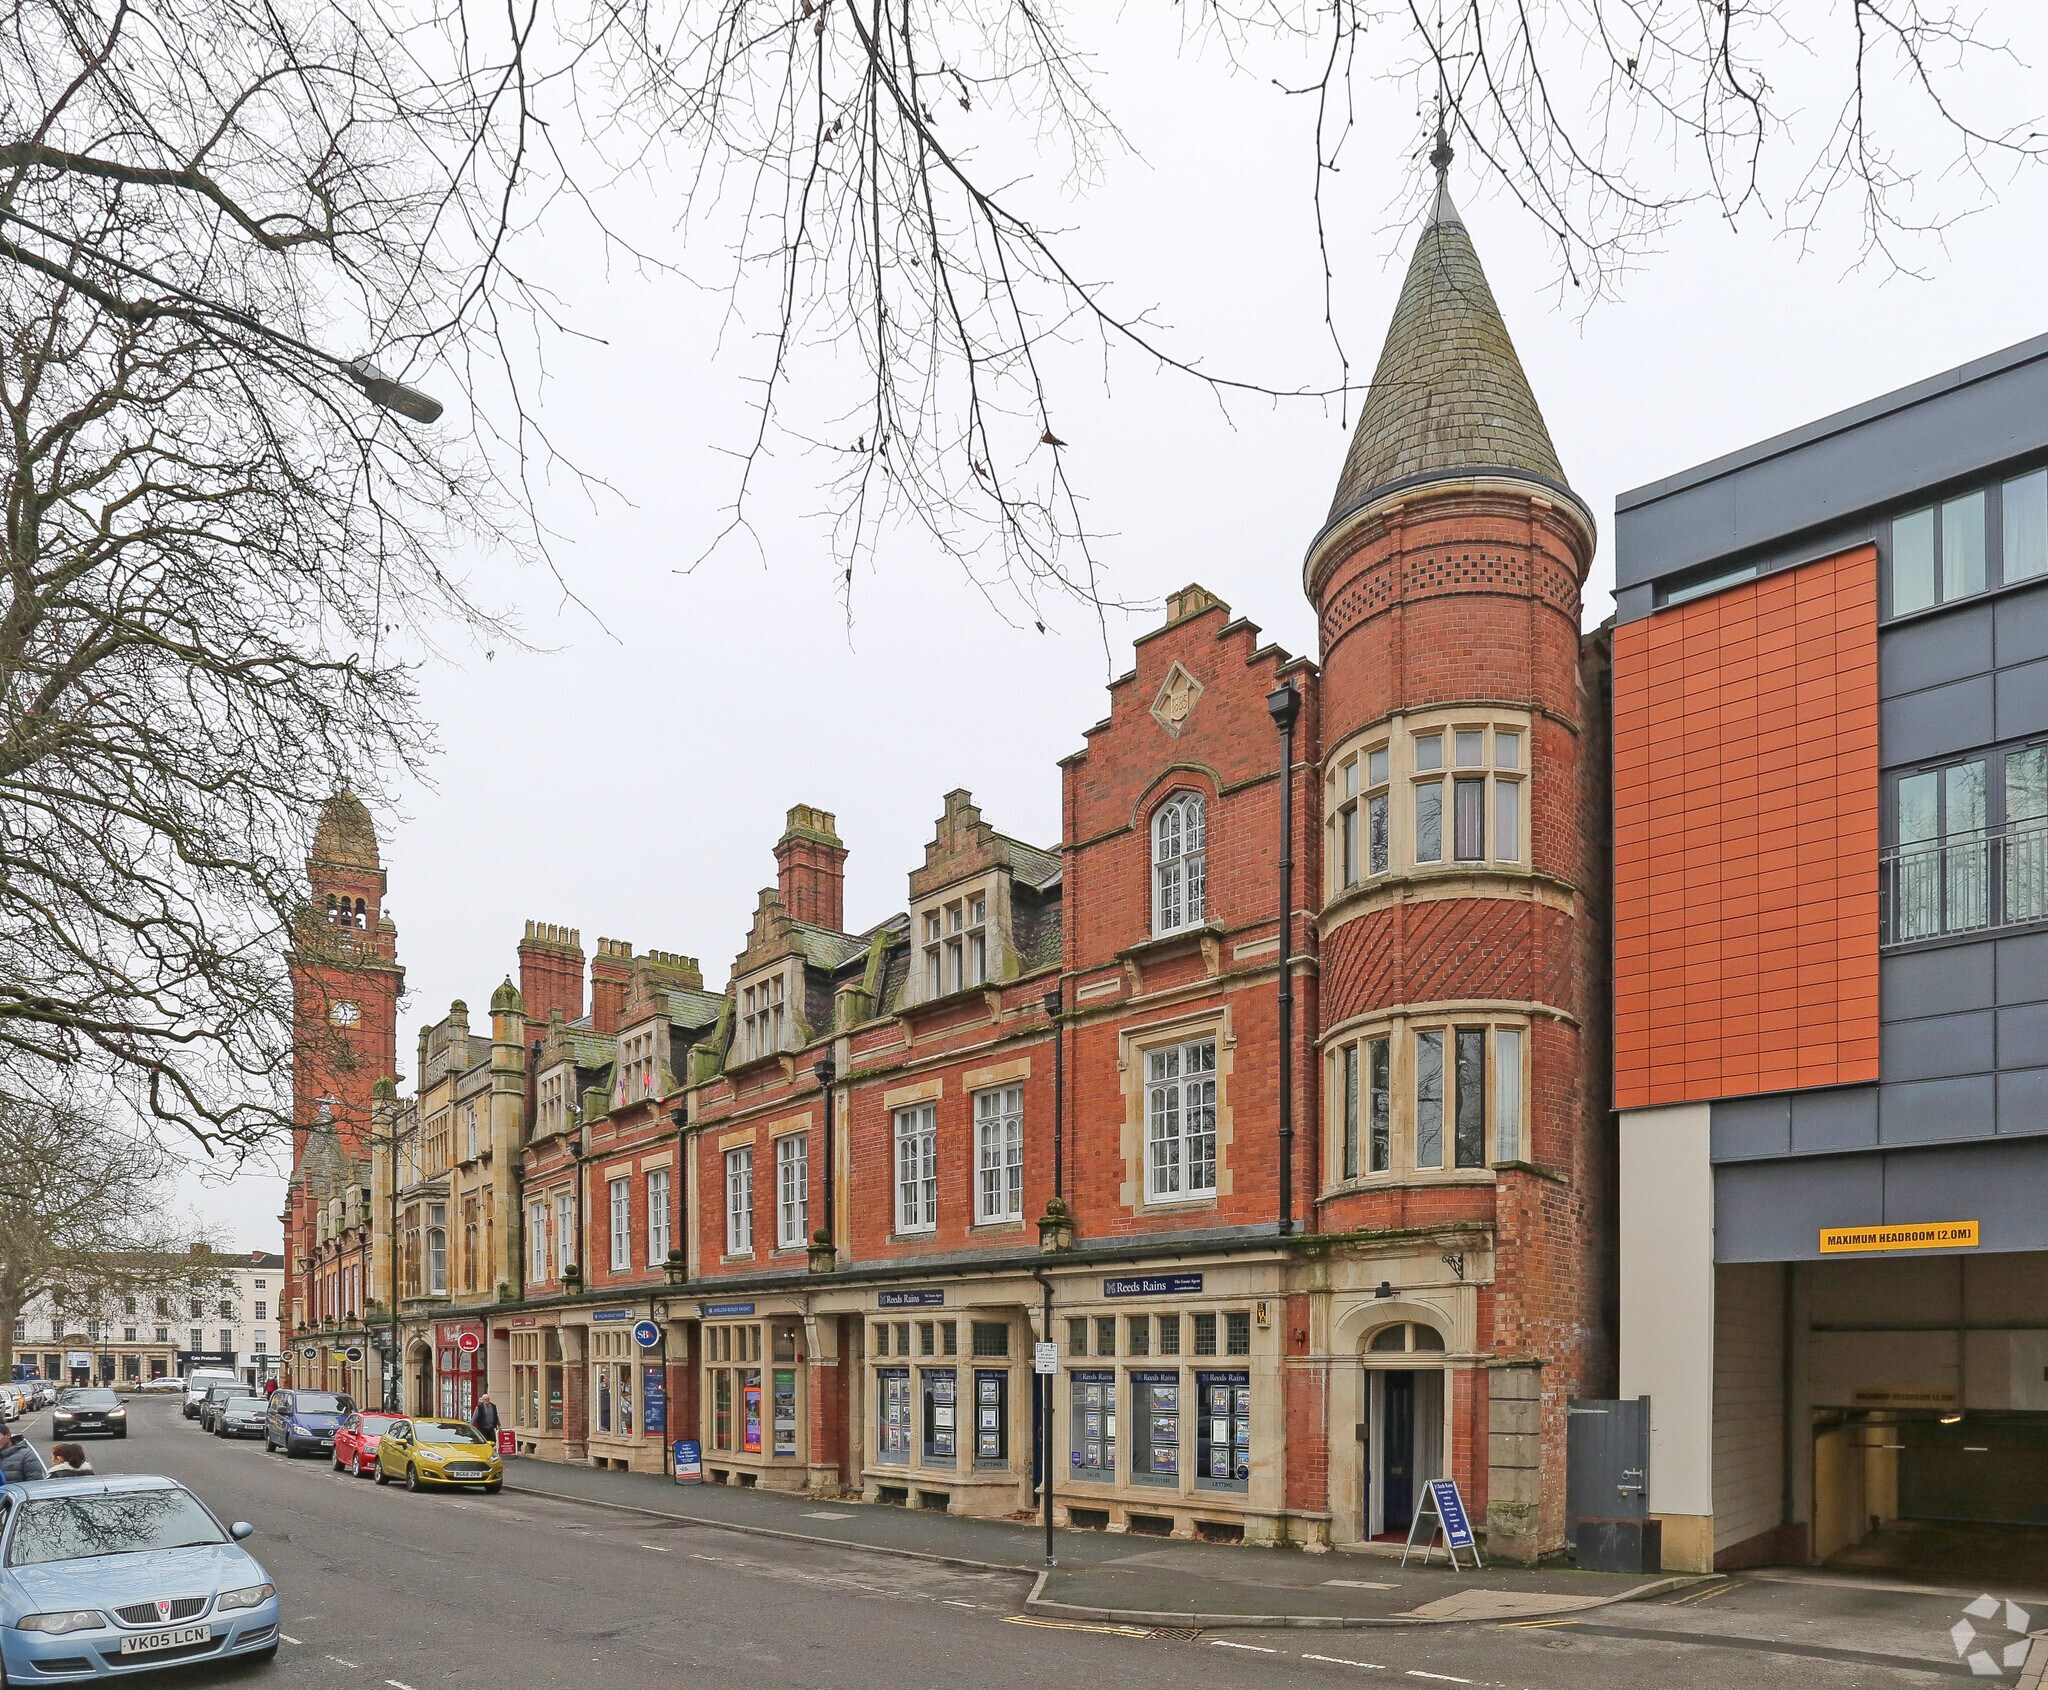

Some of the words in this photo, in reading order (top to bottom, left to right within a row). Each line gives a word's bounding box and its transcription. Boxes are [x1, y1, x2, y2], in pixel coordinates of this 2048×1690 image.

[1827, 1234, 1877, 1246] MAXIMUM
[1879, 1230, 1935, 1243] HEADROOM
[1937, 1228, 1971, 1240] (2.0M)
[1116, 1281, 1140, 1293] Reeds
[1142, 1280, 1167, 1291] Rains
[886, 1294, 903, 1304] Reeds
[903, 1294, 920, 1303] Rains
[1143, 1373, 1159, 1381] Reeds
[1160, 1373, 1177, 1381] Rains
[1209, 1374, 1227, 1382] Reeds
[1228, 1374, 1246, 1382] Rains
[128, 1633, 170, 1651] VK05
[174, 1627, 204, 1644] LCN
